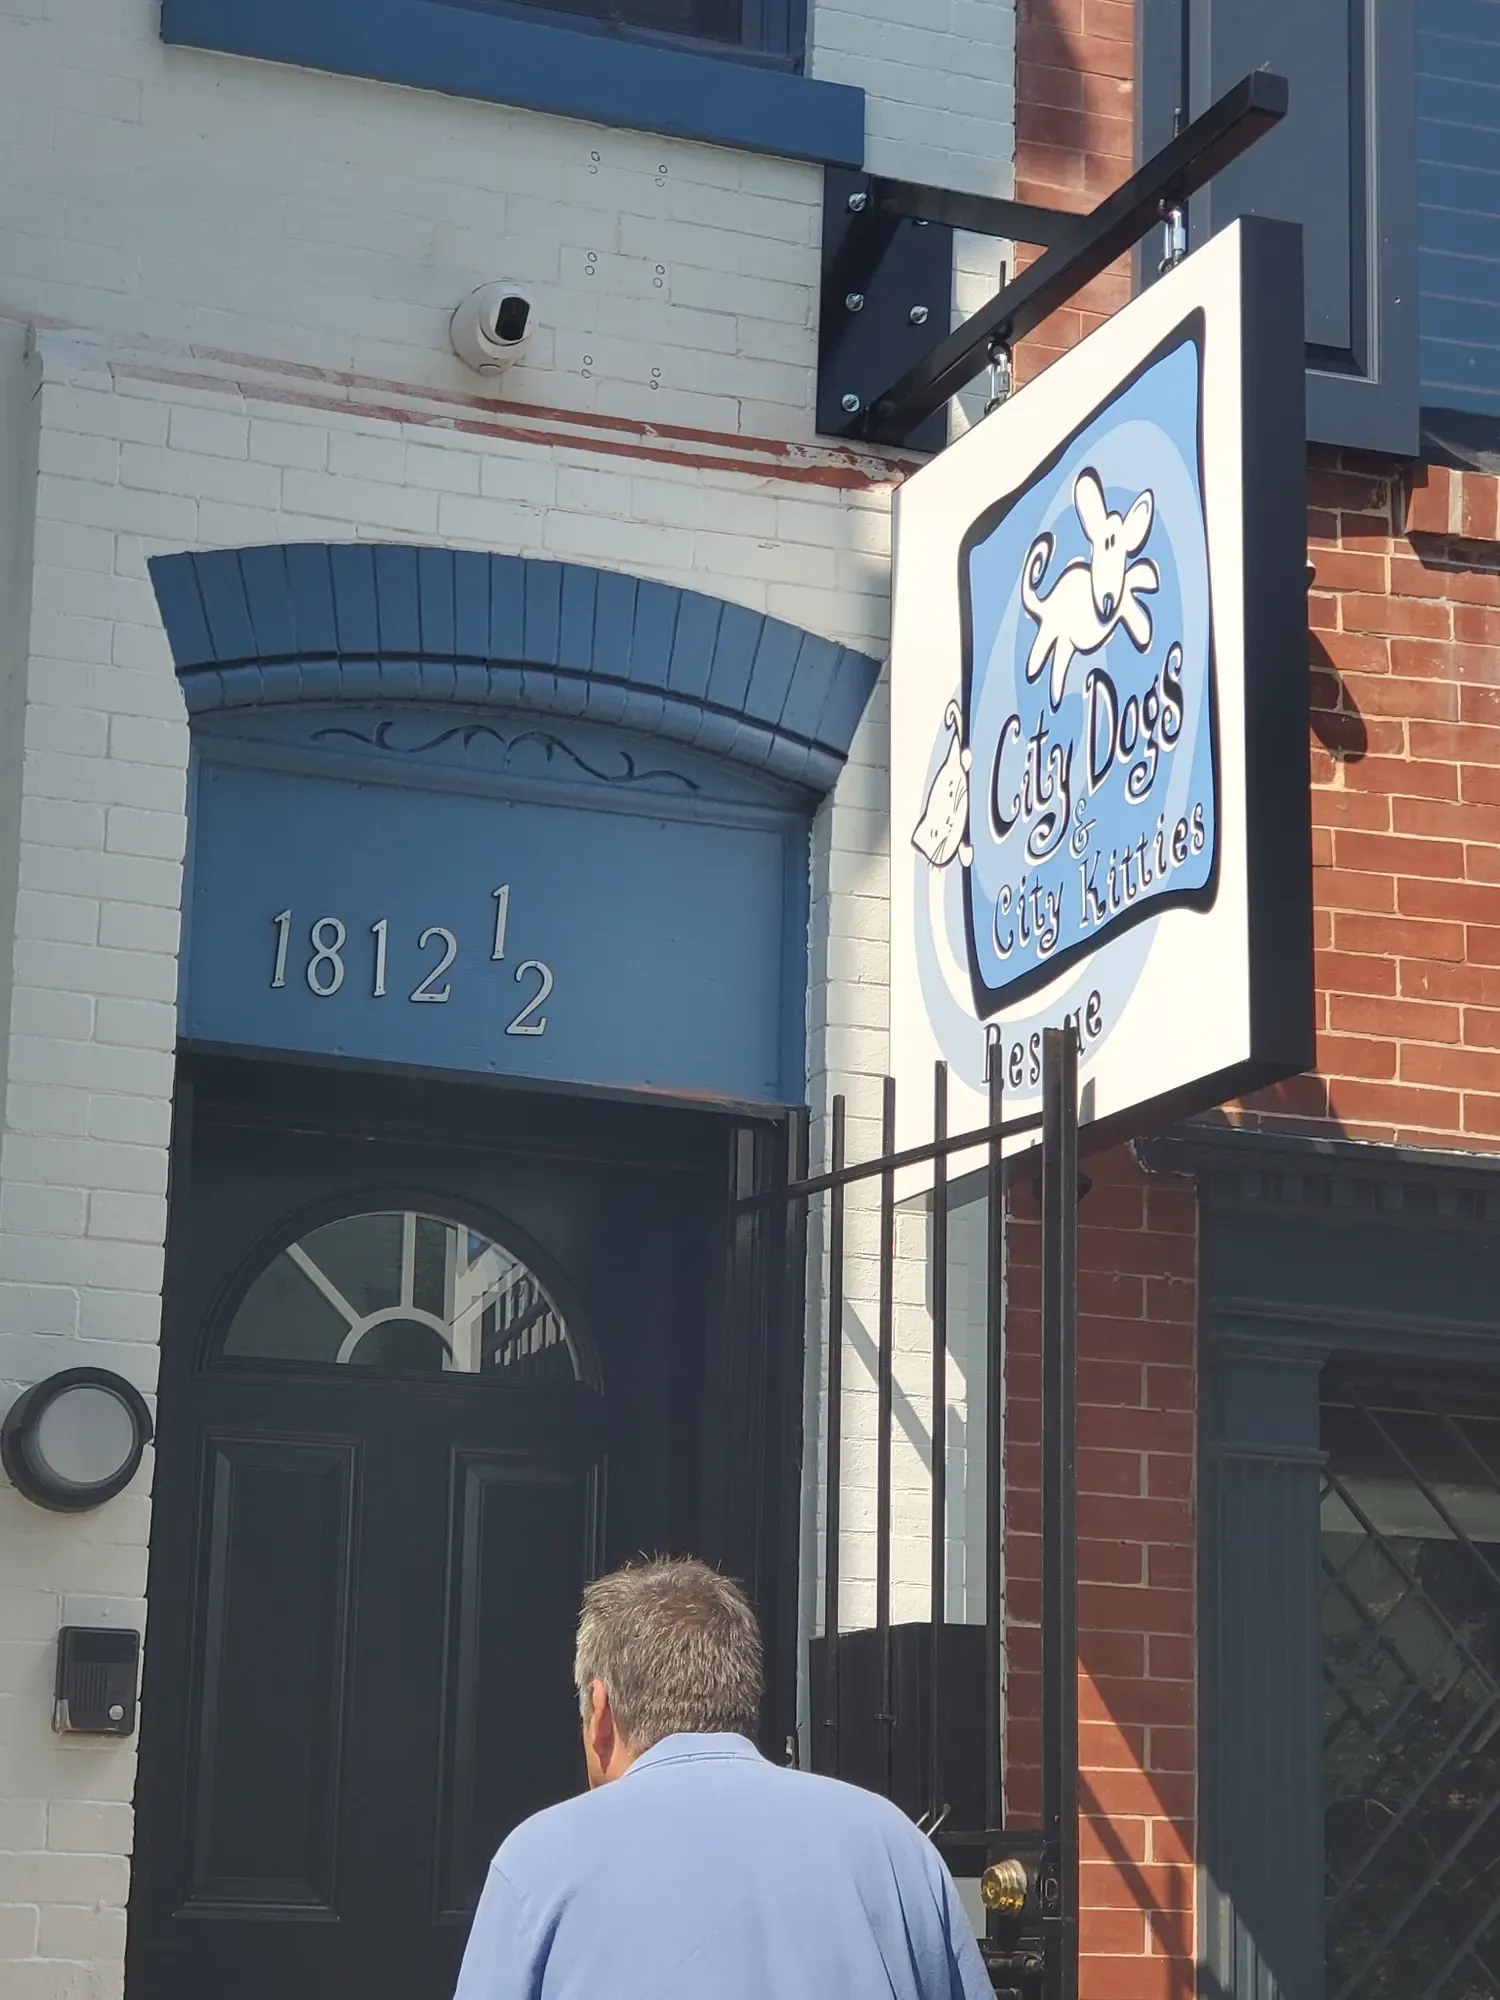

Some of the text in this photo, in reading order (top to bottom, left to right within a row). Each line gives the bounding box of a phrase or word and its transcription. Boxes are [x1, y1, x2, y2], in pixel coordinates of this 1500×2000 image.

[990, 640, 1184, 859] City Dogs
[994, 802, 1205, 957] City Kitties
[1069, 798, 1096, 856] &
[271, 908, 458, 1002] 1812
